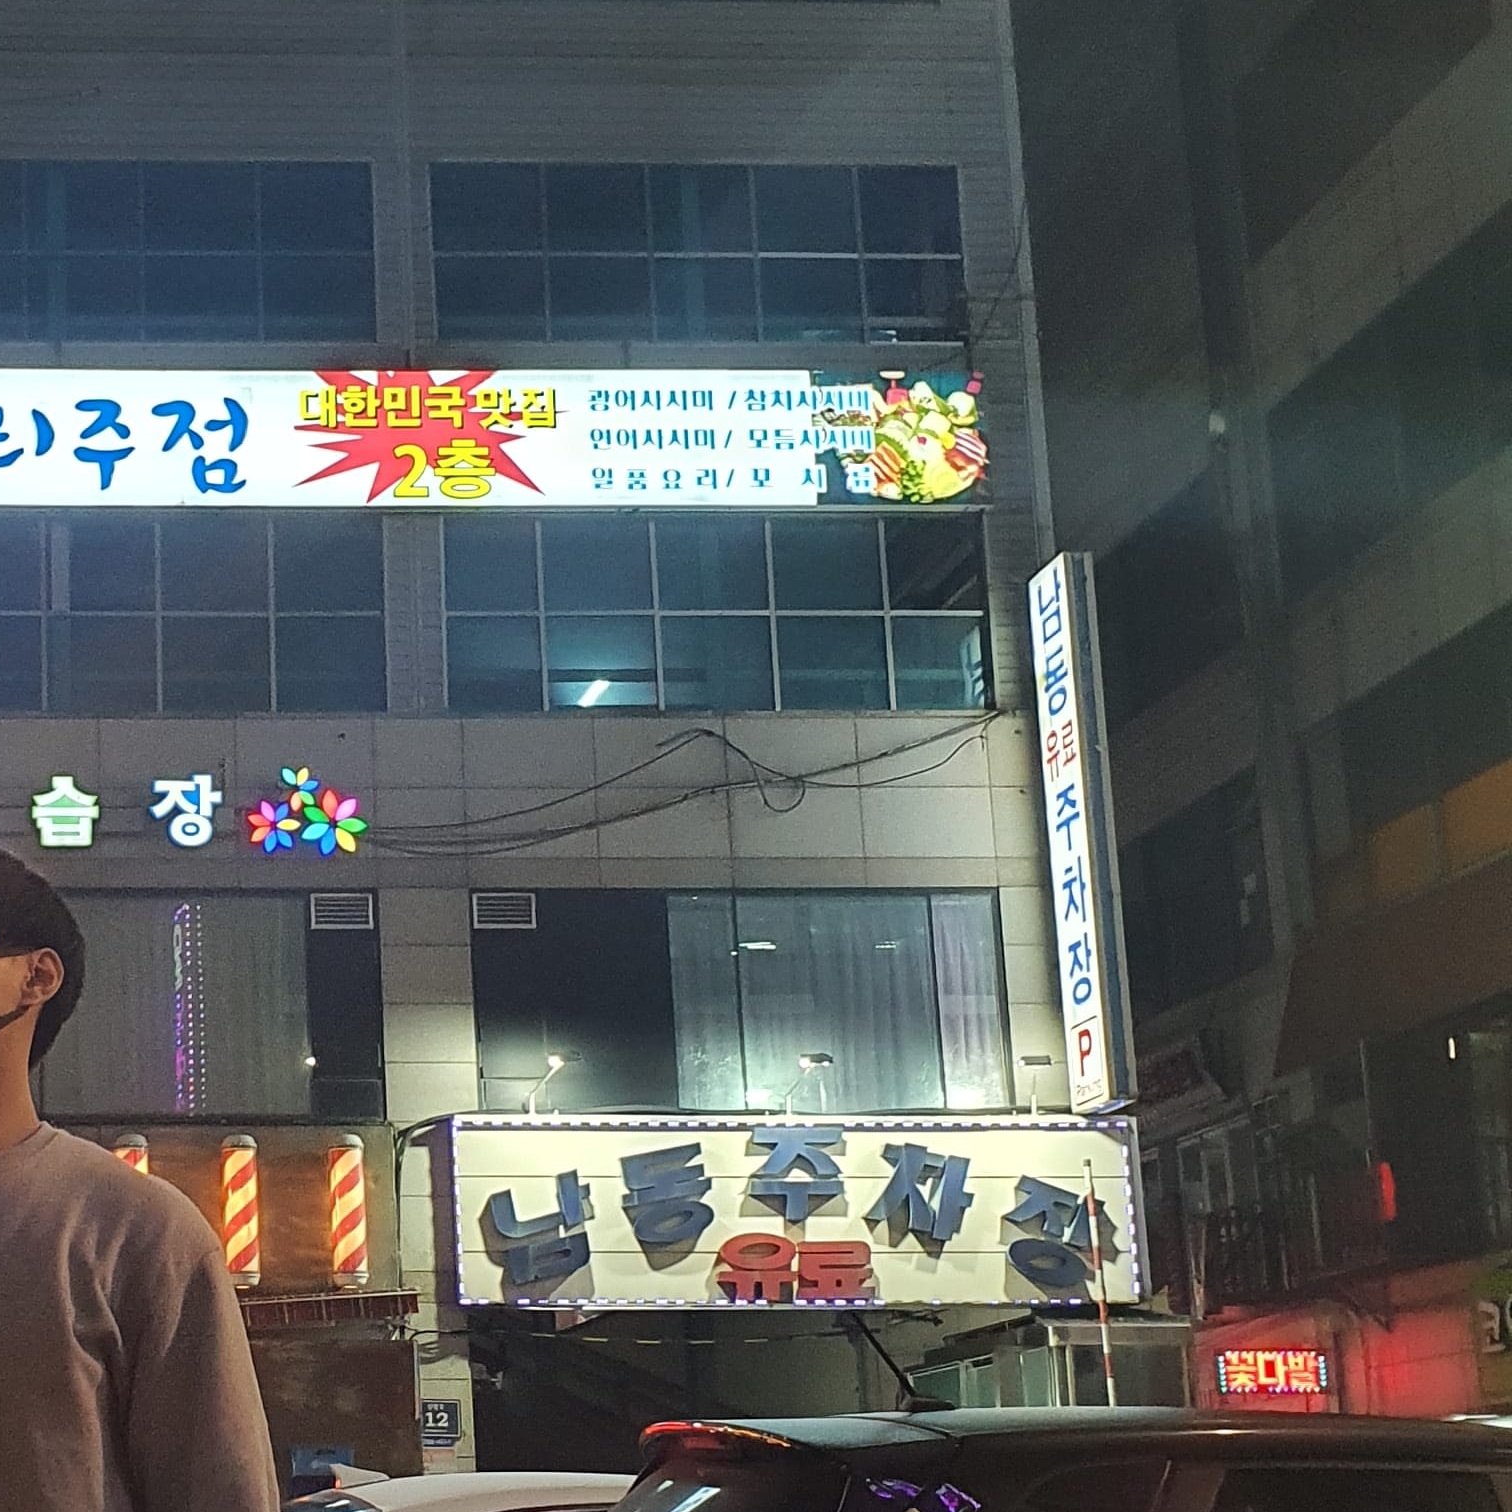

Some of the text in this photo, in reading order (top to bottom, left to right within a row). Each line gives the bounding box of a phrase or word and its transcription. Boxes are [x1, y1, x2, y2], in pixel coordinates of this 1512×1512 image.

[392, 438, 496, 499] 2층
[1078, 1028, 1092, 1077] P
[424, 1411, 449, 1428] 12
